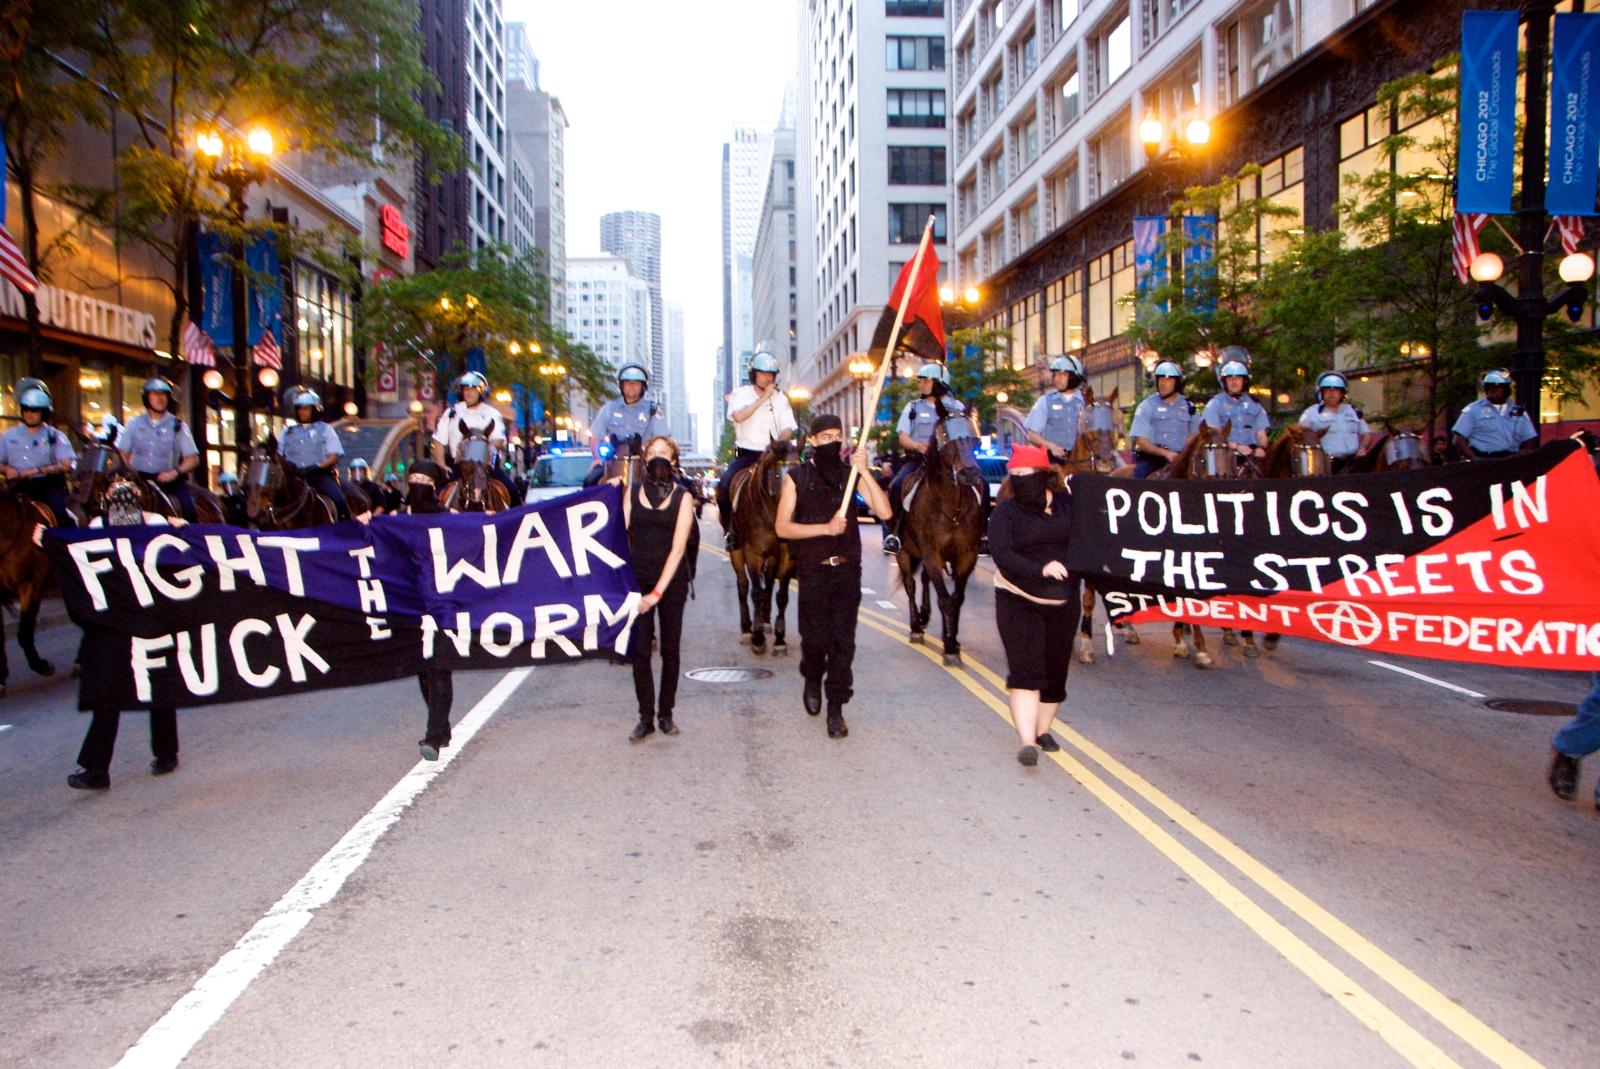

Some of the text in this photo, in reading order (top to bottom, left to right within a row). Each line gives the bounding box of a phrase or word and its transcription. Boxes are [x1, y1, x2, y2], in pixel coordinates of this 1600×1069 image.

[1477, 91, 1489, 181] CHICAGO 2012
[1488, 50, 1501, 180] The Global Crossroads
[1564, 92, 1578, 184] CHICAGO 2012
[1575, 51, 1591, 184] The Global Crossroads
[34, 284, 157, 350] OUTFITTERS
[1105, 474, 1548, 542] POLITICS IS IN
[68, 501, 626, 610] FIGHT WAR
[349, 546, 391, 640] THE
[1120, 547, 1544, 597] THE STREETS
[132, 592, 642, 702] FUCK NORM
[1105, 591, 1300, 627] STUDENT
